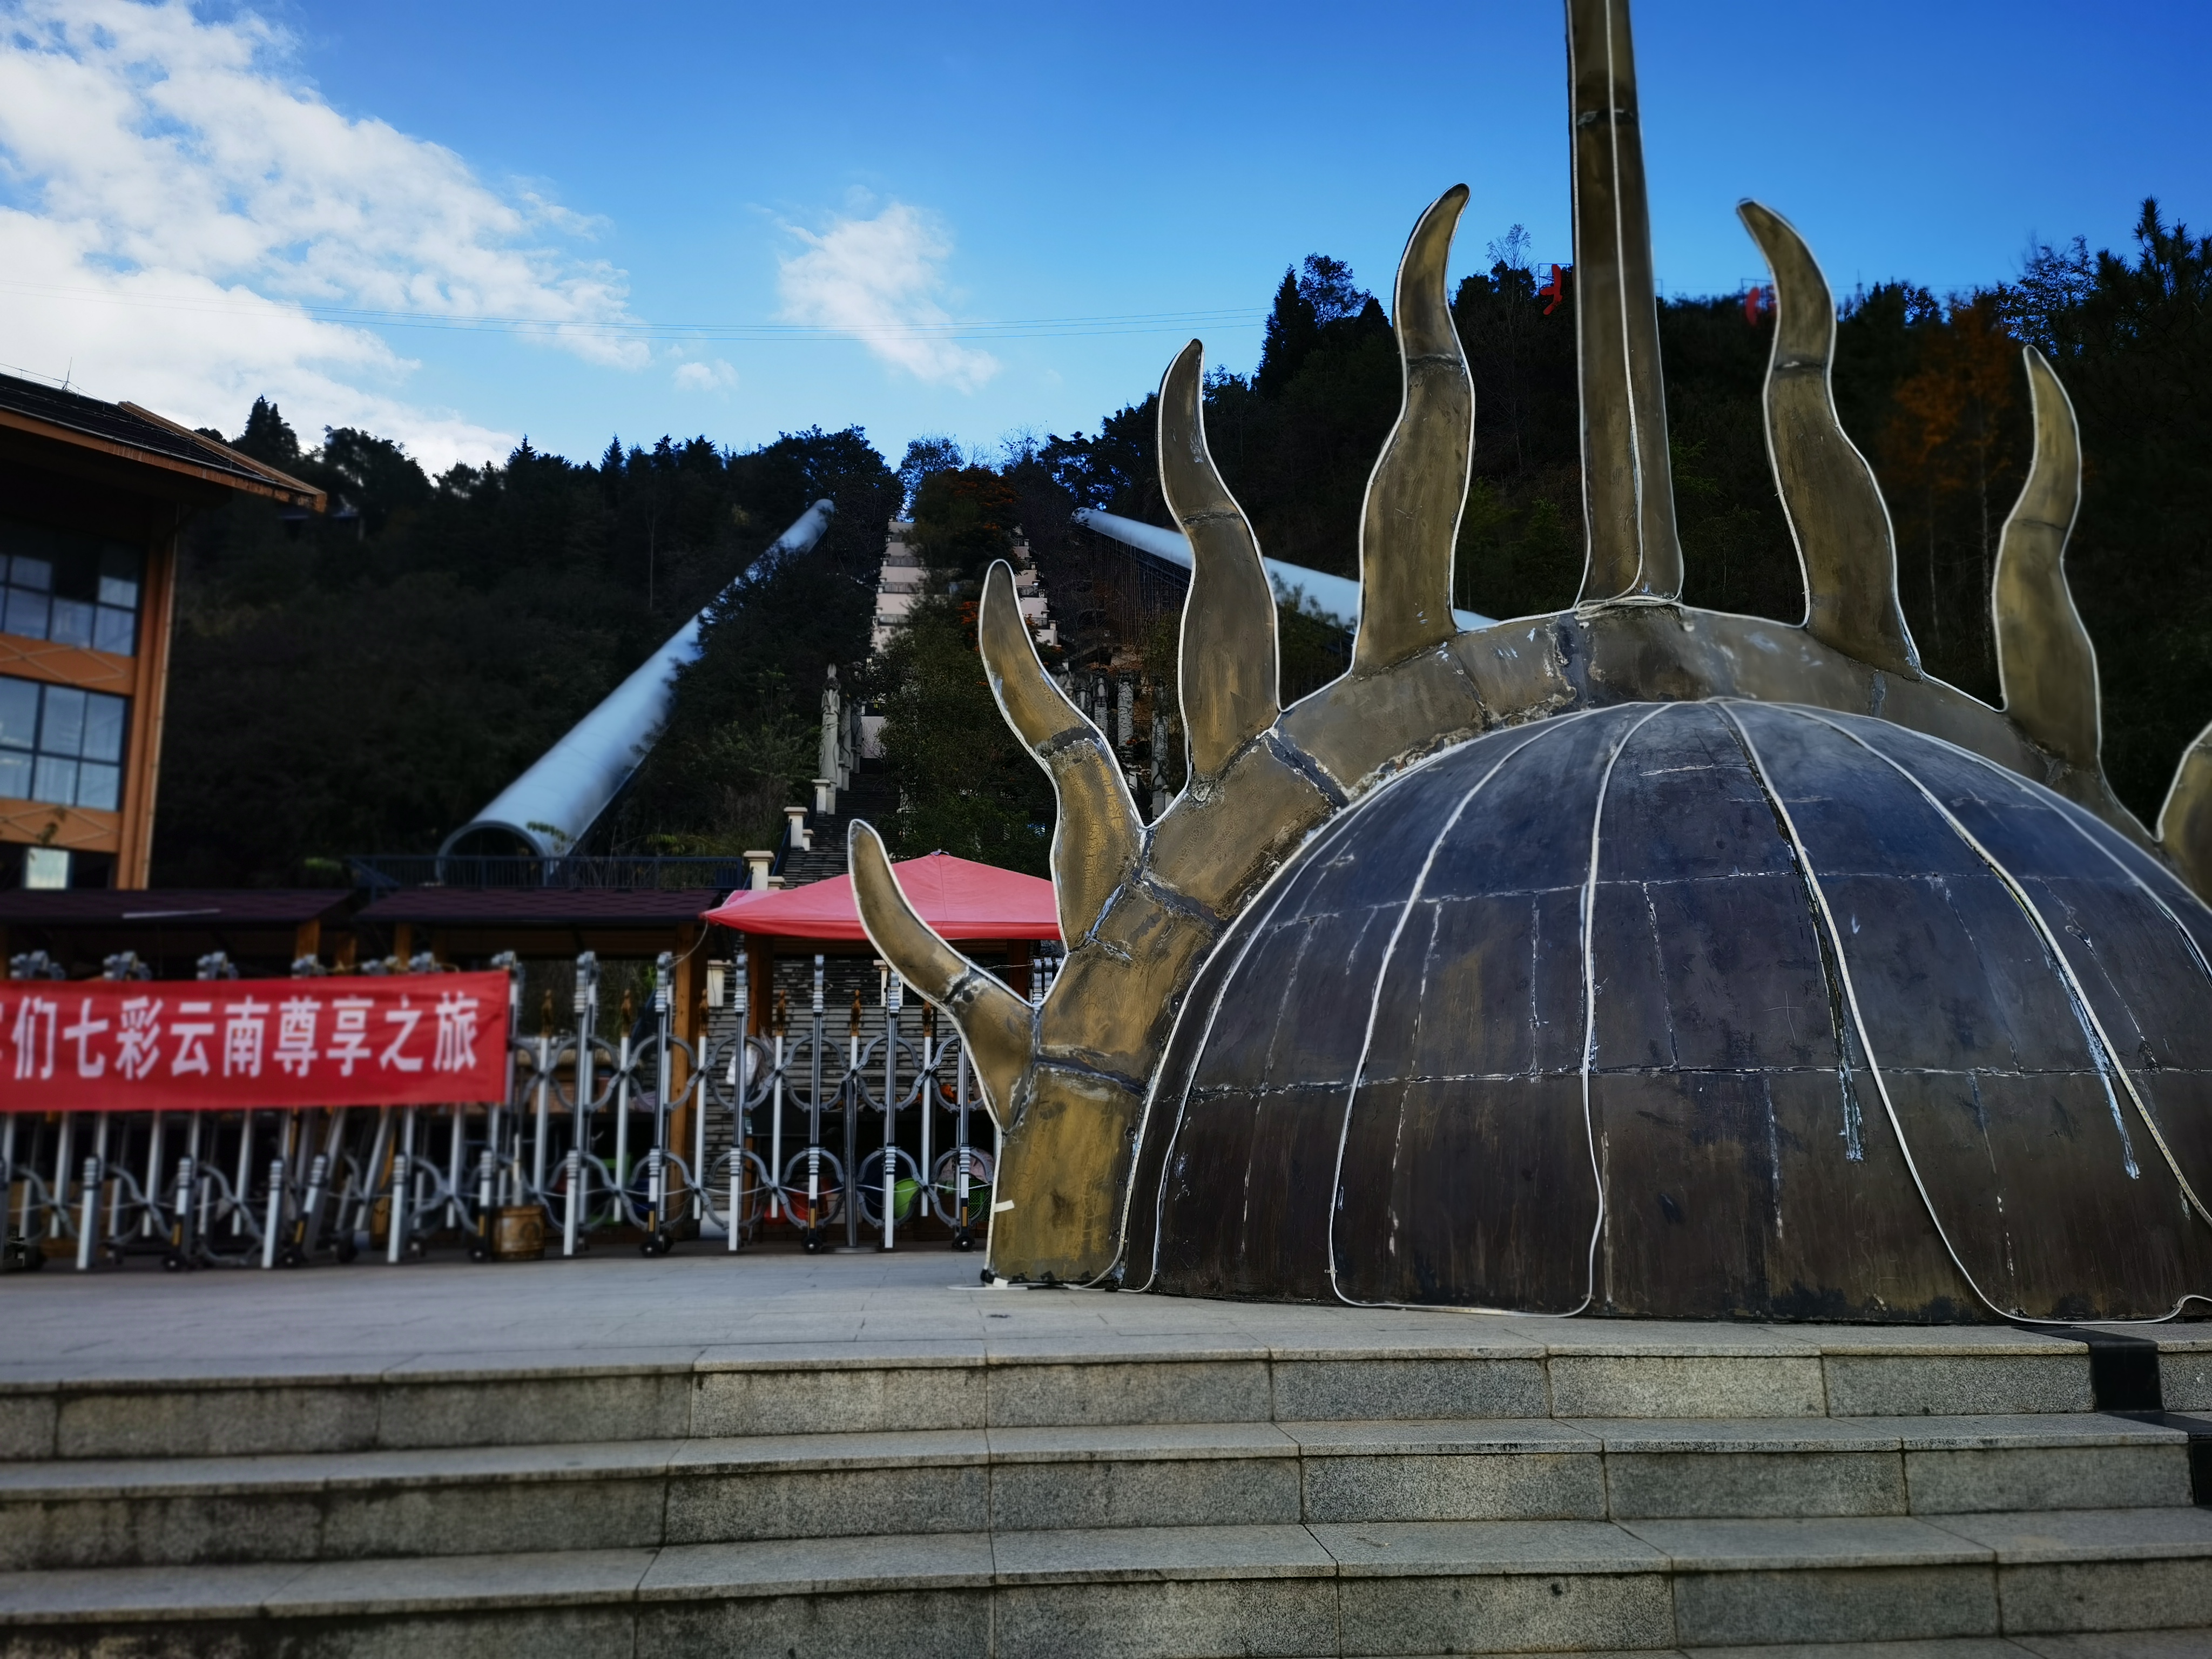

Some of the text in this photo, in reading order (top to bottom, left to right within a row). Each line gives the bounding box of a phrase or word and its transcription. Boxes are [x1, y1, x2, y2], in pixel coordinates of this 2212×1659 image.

[0, 991, 478, 1080] 们七彩云南尊享之旅
